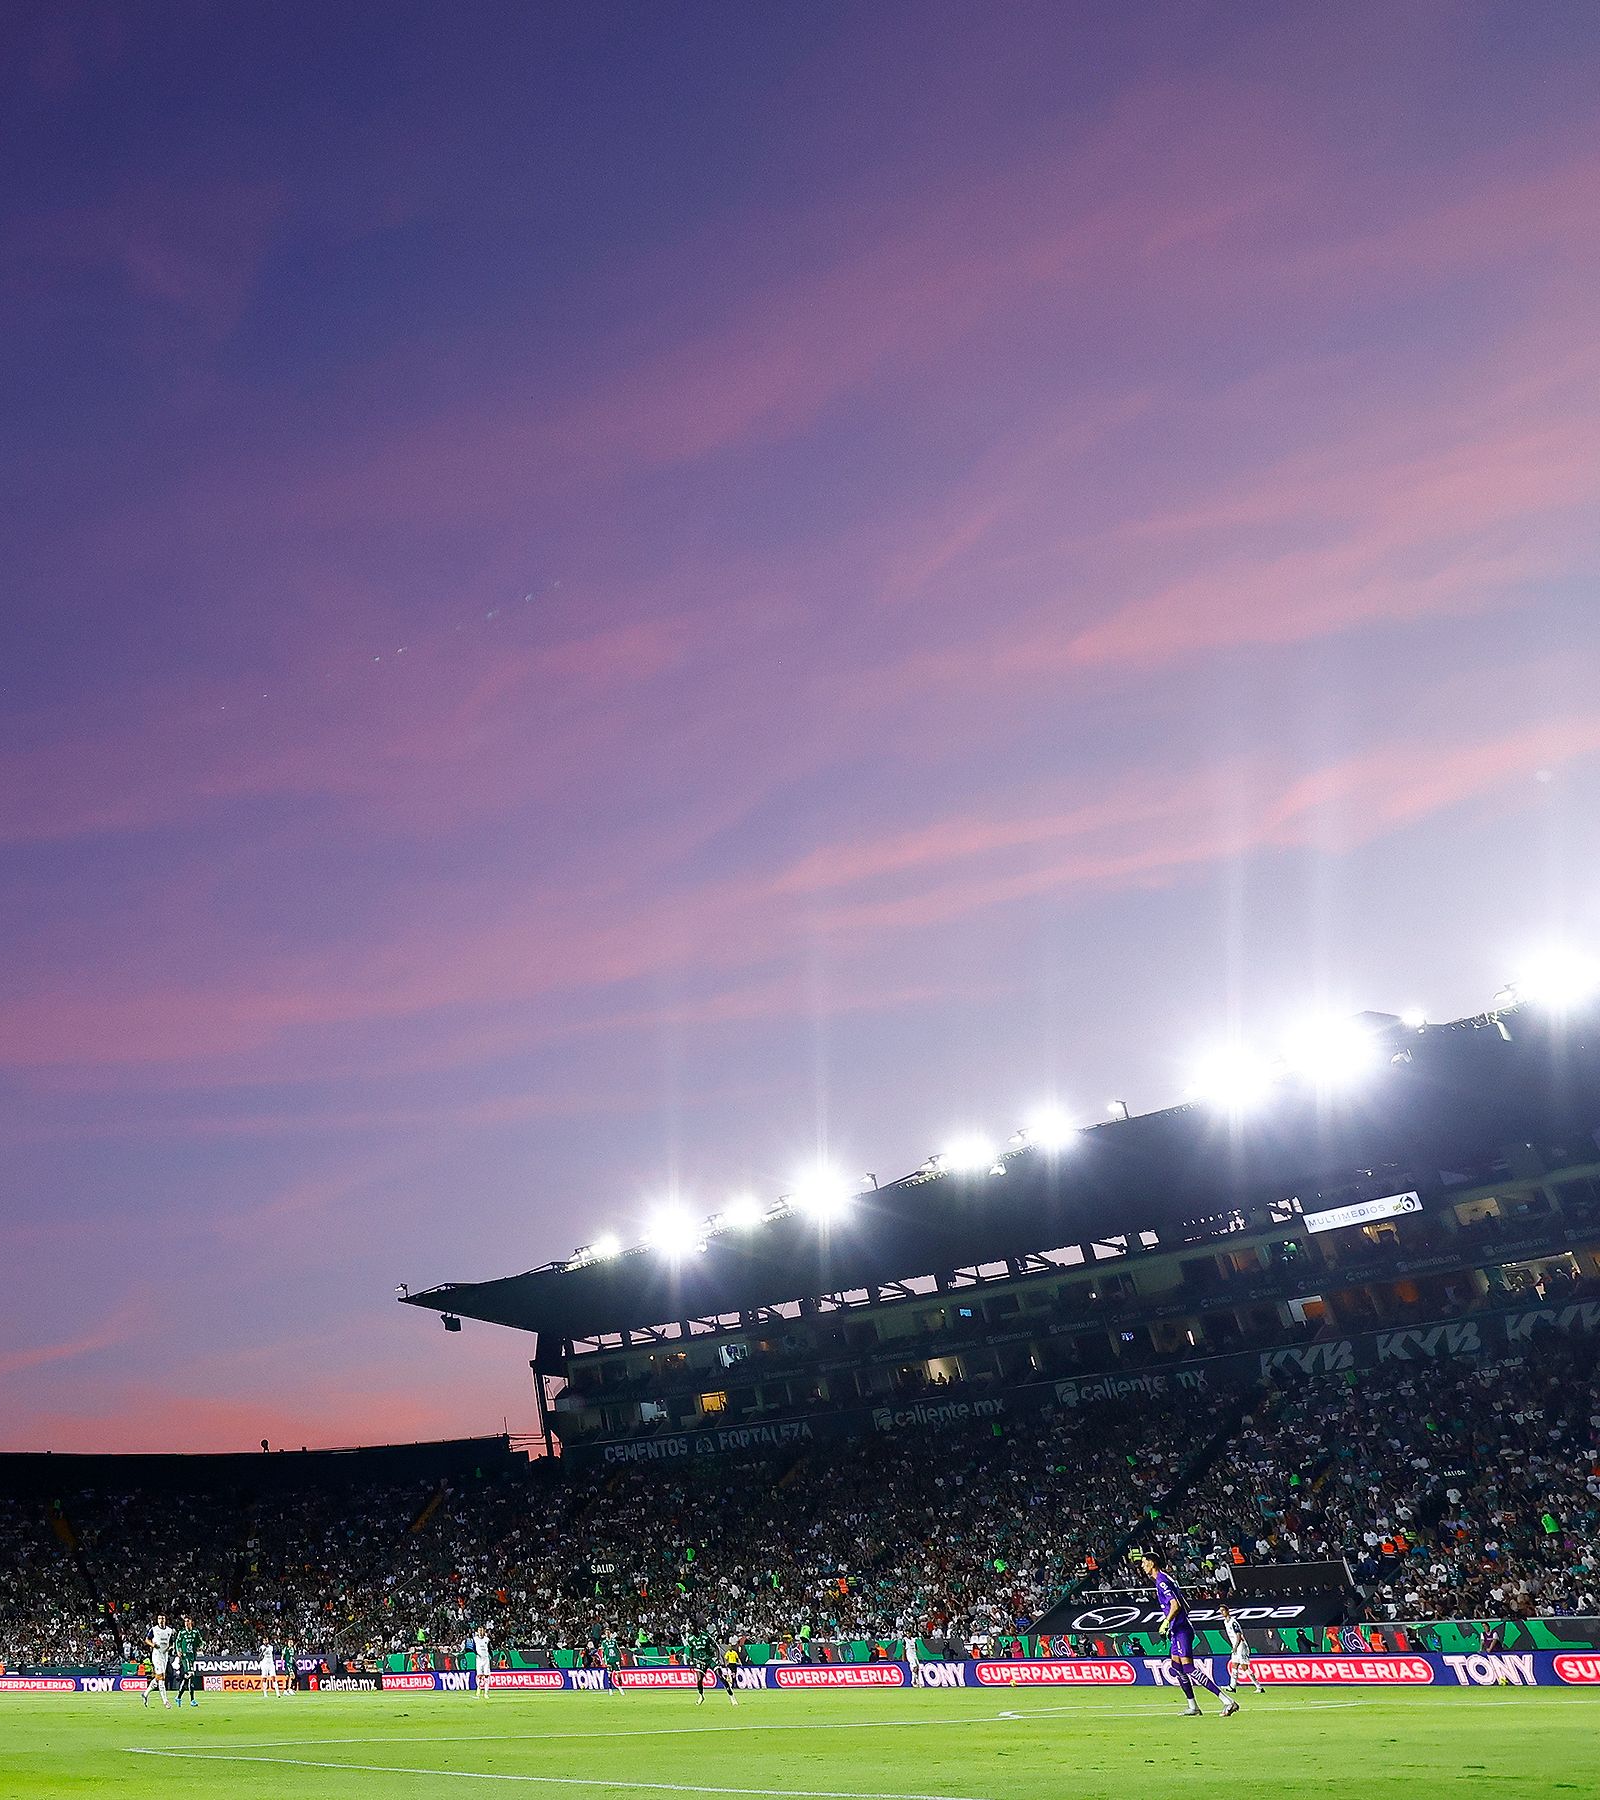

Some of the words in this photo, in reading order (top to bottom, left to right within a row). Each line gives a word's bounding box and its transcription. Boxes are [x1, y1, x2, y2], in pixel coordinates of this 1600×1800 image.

[1308, 1204, 1386, 1227] MULTIMEDIOS
[894, 1399, 1006, 1427] caliente.mx
[604, 1438, 688, 1463] CEMENTOS
[590, 1563, 615, 1574] SALID
[779, 1668, 900, 1685] SUPERPAPELERIAS
[980, 1664, 1131, 1681] SUPERPAPELERIAS
[1443, 1653, 1538, 1686] TONY
[80, 1678, 114, 1692] TONY
[319, 1675, 376, 1692] caliente.mx
[439, 1672, 470, 1690] TONY
[568, 1669, 605, 1690] TONY
